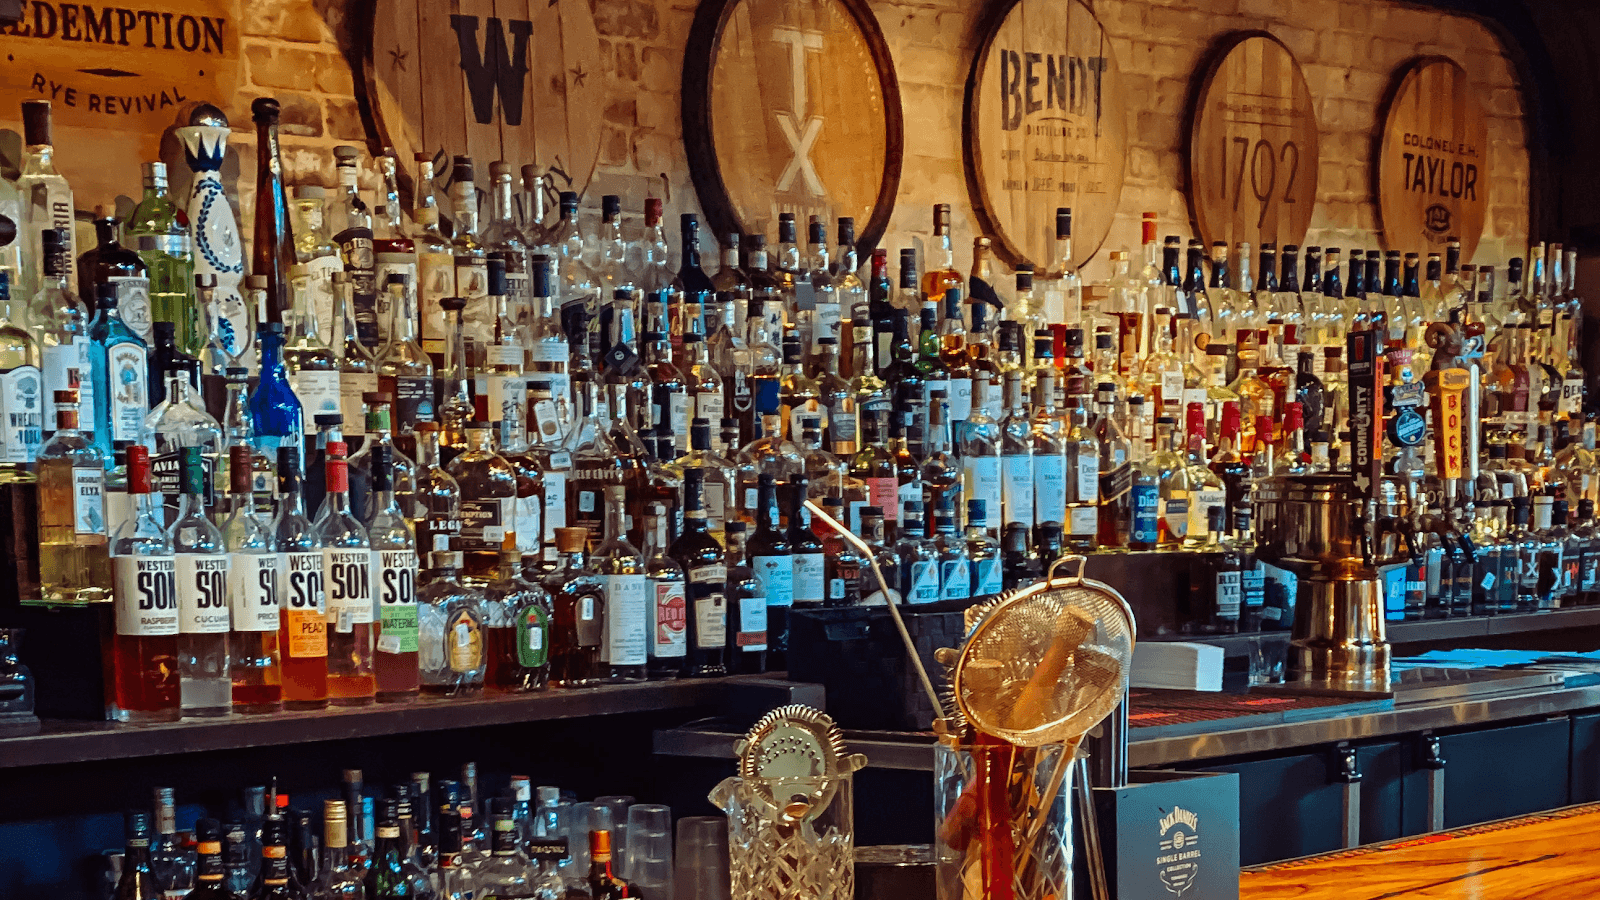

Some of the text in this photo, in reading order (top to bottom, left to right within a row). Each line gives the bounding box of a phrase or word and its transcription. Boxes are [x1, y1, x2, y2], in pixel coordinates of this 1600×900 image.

[0, 0, 225, 54] EDEMPTION
[31, 73, 186, 115] RYE REVIVAL
[450, 14, 533, 126] W
[1001, 48, 1108, 132] BENDT
[1403, 132, 1454, 154] COLONEL
[1221, 136, 1299, 229] 1792
[1403, 152, 1478, 201] TAYLOR
[1356, 386, 1371, 466] COMMUNITY
[1448, 395, 1458, 471] BOCK
[80, 486, 99, 496] ELYX
[331, 563, 370, 599] SON
[1156, 850, 1202, 865] SINGLE BARREL
